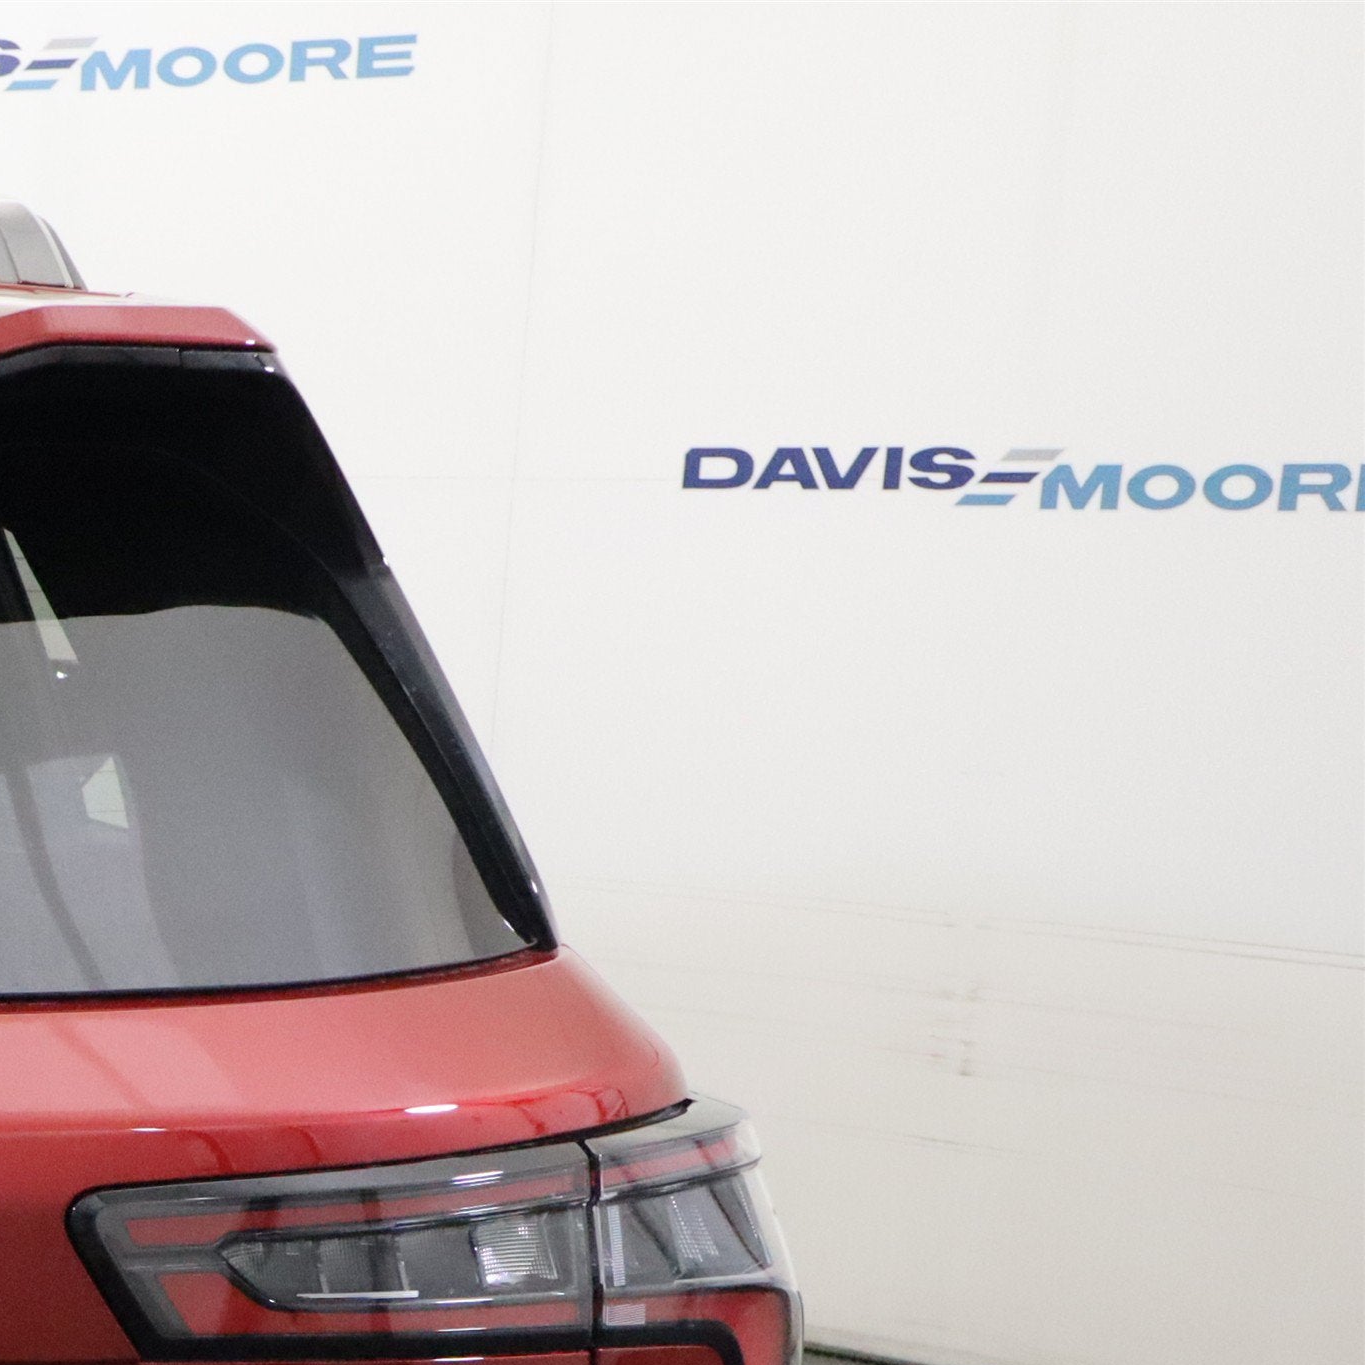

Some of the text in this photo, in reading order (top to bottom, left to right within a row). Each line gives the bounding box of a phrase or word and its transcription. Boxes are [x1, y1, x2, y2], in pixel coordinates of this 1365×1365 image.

[80, 34, 418, 92] MOORE
[682, 446, 1365, 512] DAVIS MOOR
